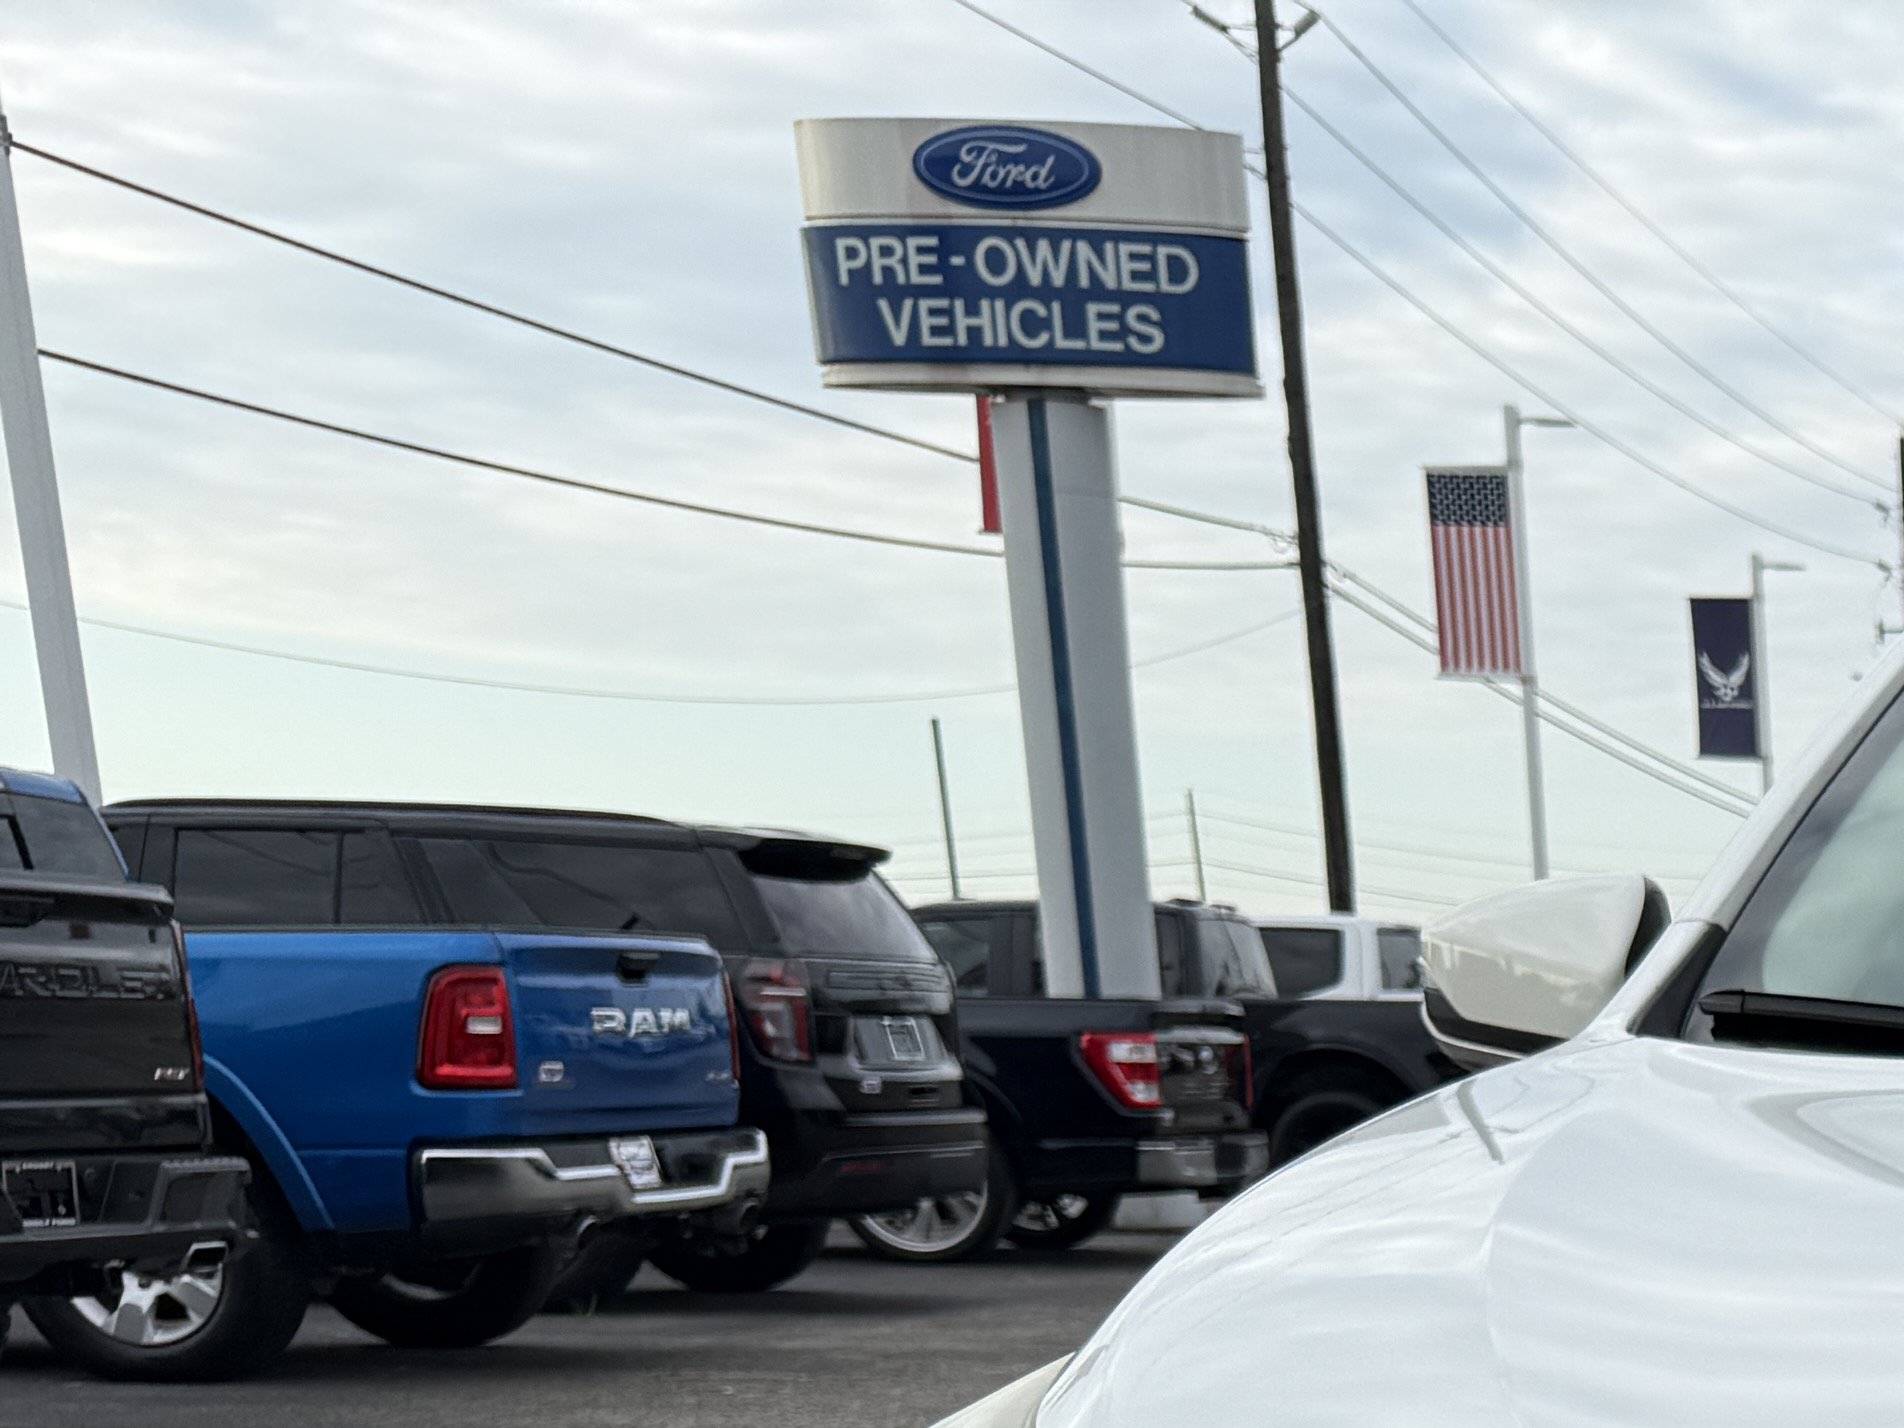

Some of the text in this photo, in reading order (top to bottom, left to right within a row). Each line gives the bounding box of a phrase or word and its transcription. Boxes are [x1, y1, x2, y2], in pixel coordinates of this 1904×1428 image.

[952, 140, 1056, 190] Ford
[835, 236, 1199, 294] PRE-OWNED
[877, 298, 1166, 354] VEHICLES
[591, 1007, 691, 1038] RAM
